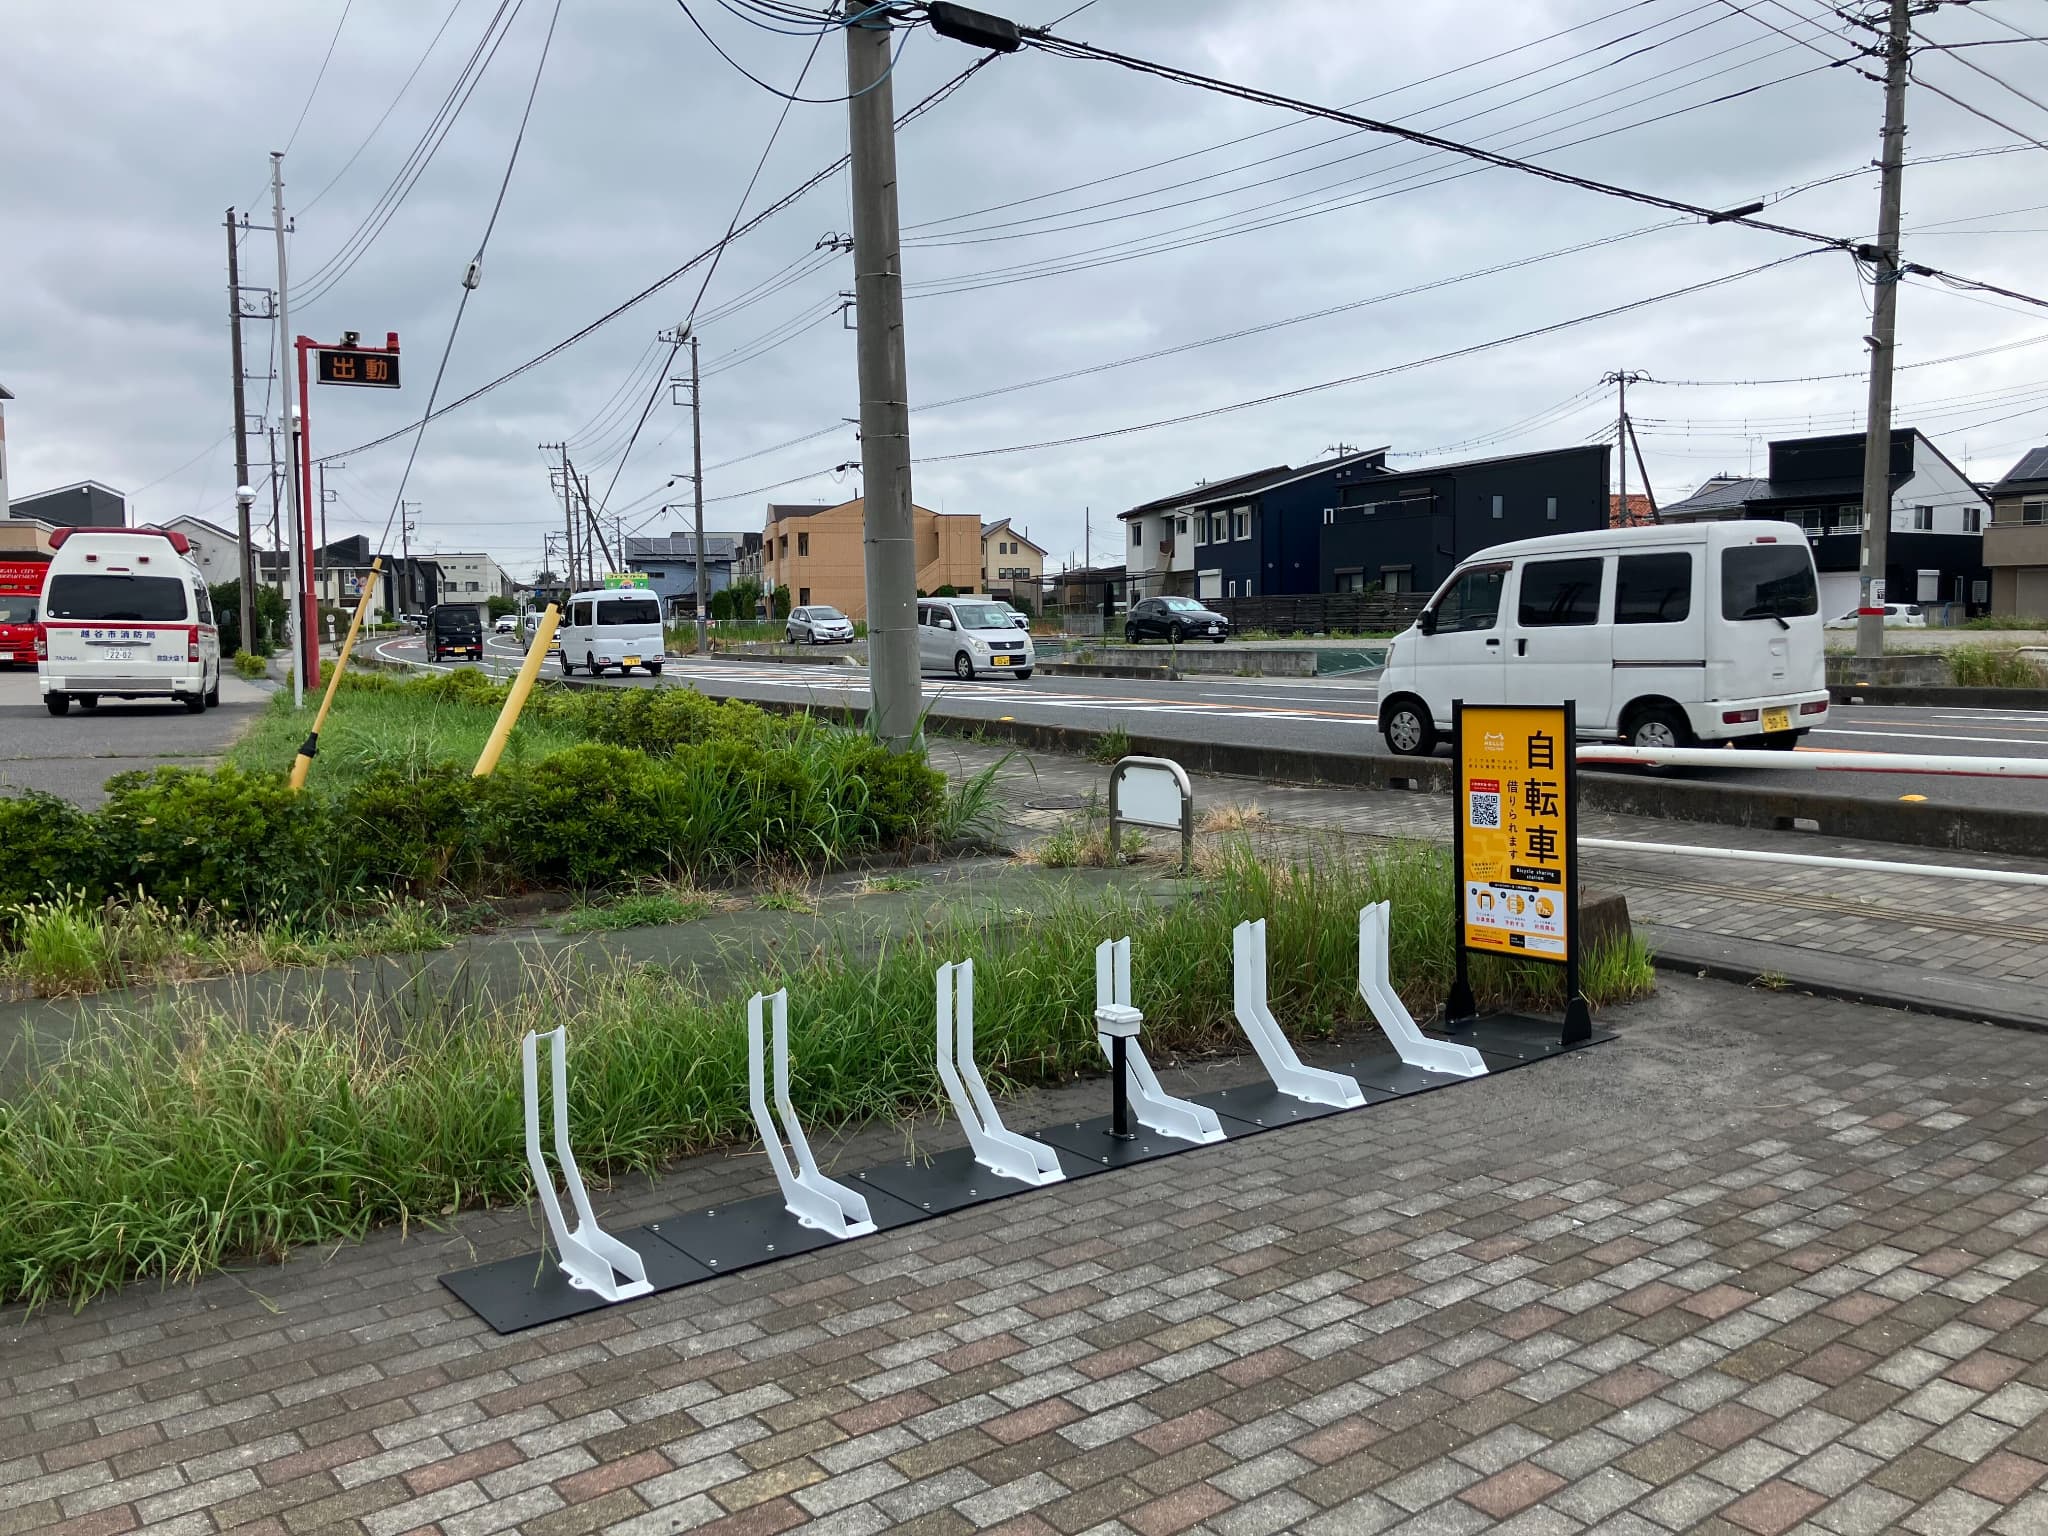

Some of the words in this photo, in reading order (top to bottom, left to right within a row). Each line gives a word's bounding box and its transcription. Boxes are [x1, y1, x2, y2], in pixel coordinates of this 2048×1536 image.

[333, 356, 388, 380] 出動
[80, 630, 156, 639] 越谷市消防局
[1524, 730, 1559, 864] 自転車
[1507, 780, 1519, 860] 借りられます
[1516, 867, 1535, 875] Bicycle
[1536, 869, 1555, 878] sharing
